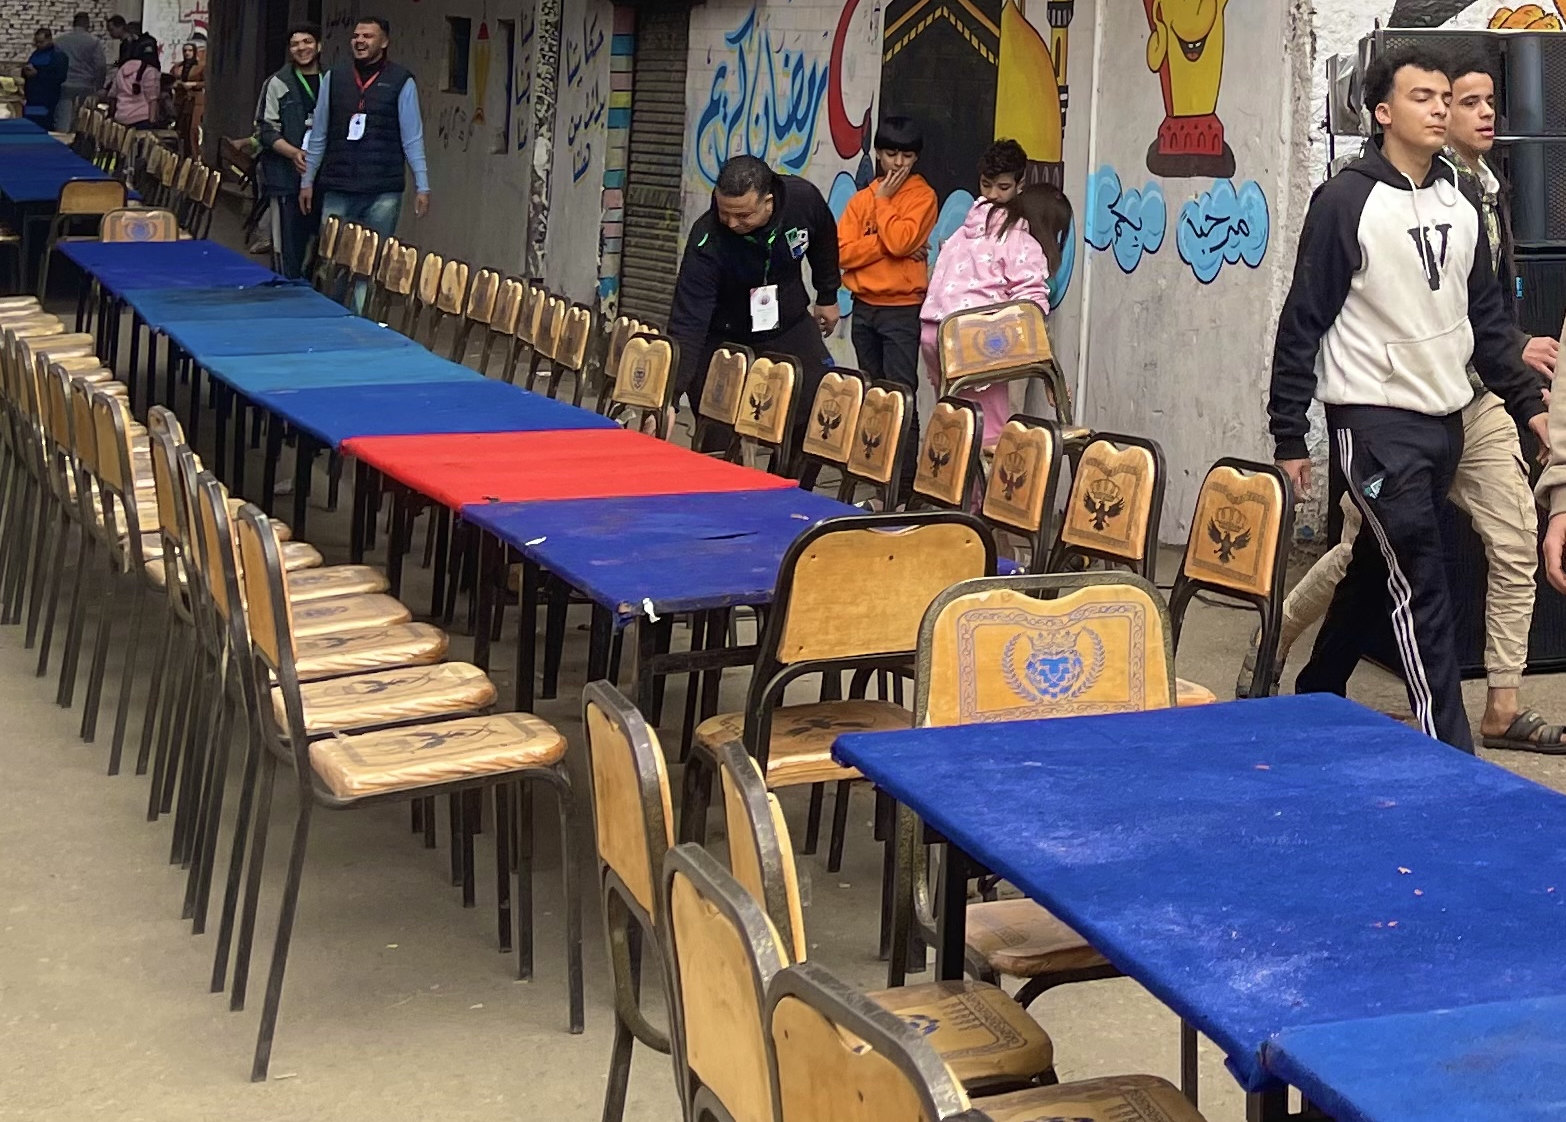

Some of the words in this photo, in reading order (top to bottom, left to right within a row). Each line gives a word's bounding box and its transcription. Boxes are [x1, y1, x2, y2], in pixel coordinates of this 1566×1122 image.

[696, 3, 757, 186] كريم
[745, 26, 829, 170] رمضان
[1186, 213, 1250, 255] مرحبا
